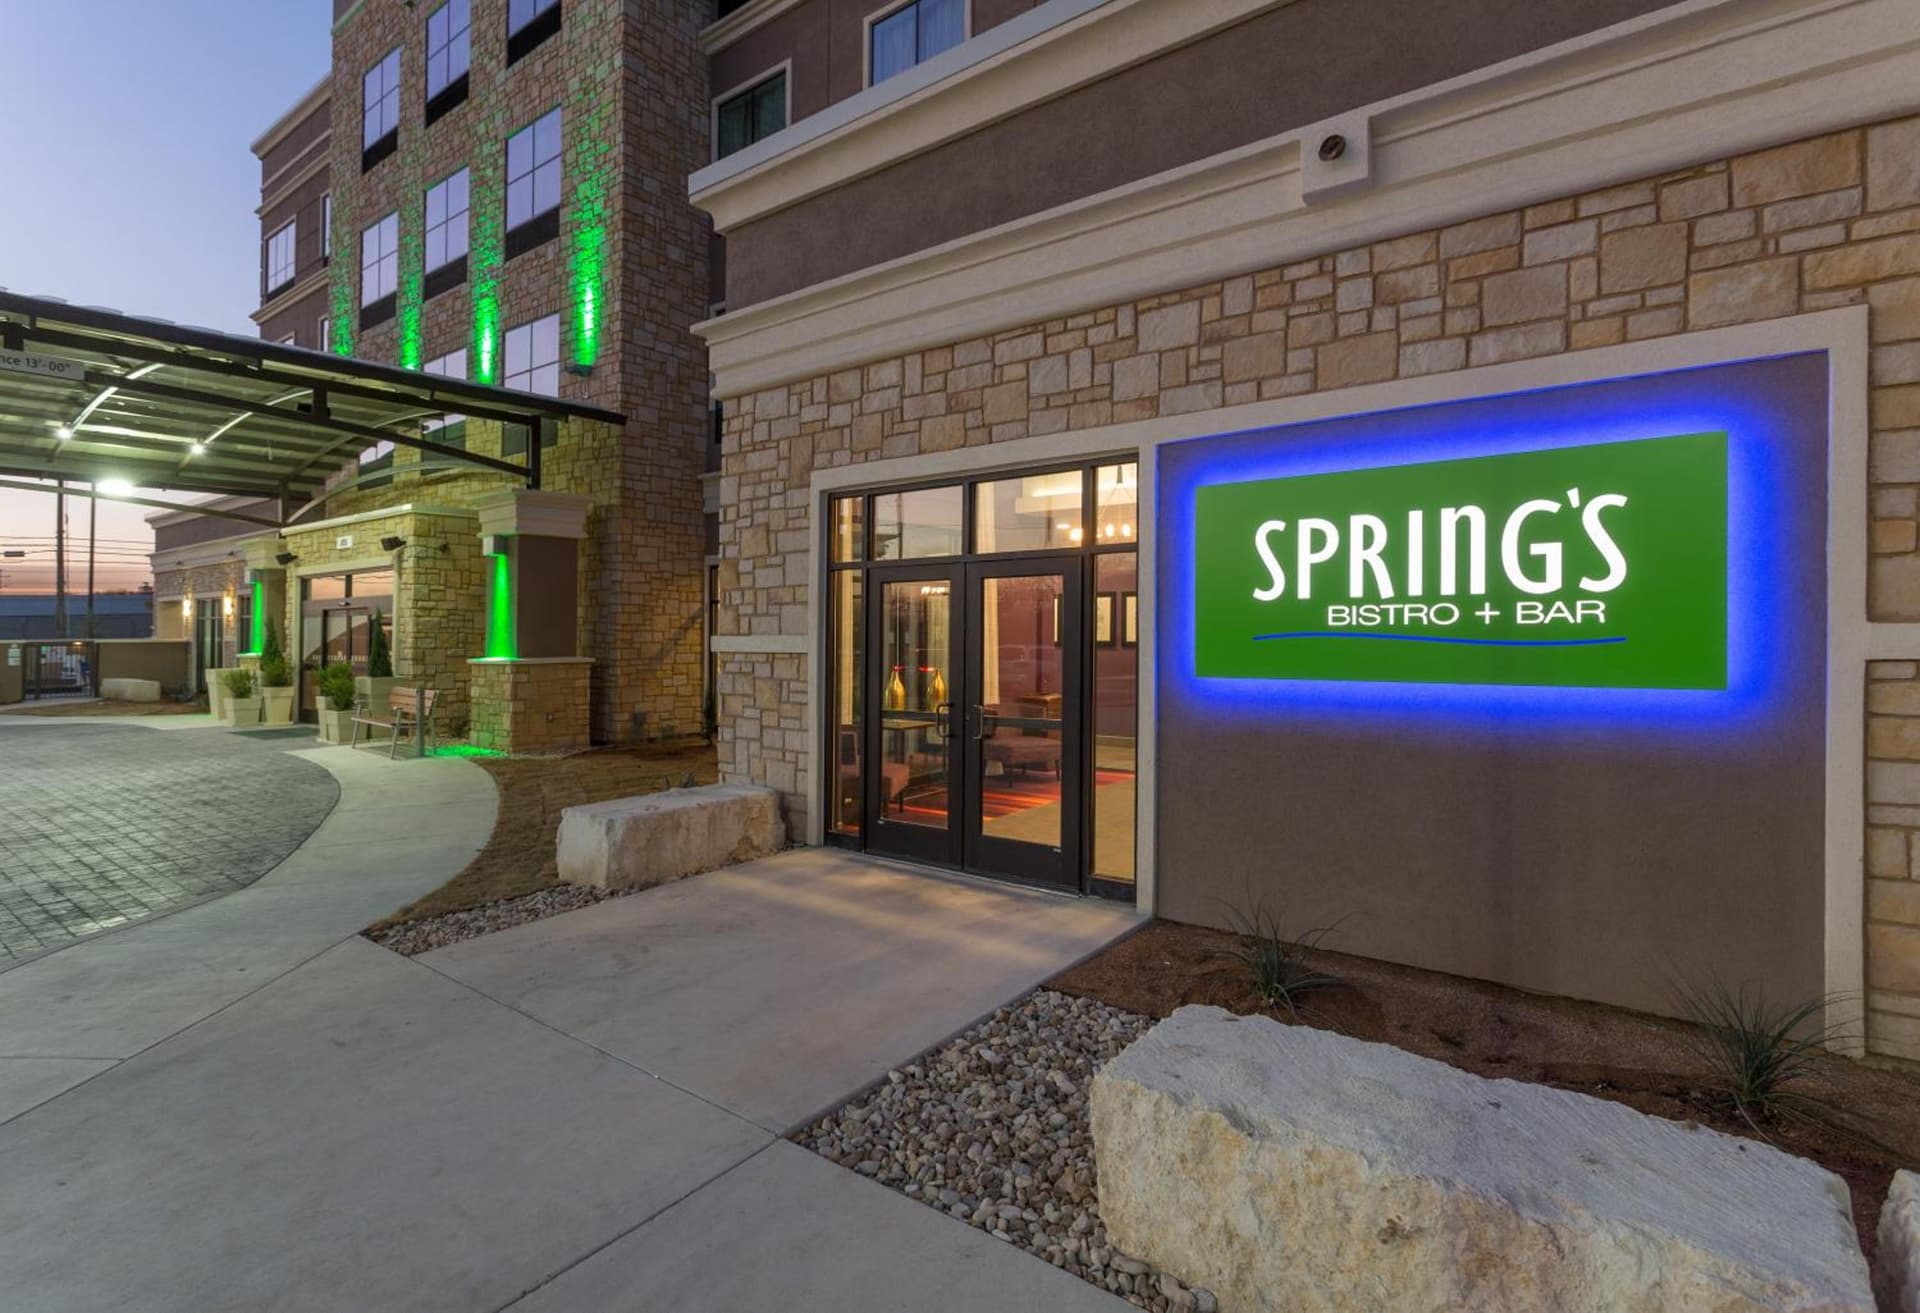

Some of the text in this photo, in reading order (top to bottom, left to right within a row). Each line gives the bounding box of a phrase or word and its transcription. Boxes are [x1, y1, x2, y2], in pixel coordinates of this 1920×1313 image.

[1327, 600, 1606, 626] BISTRO + BAR
